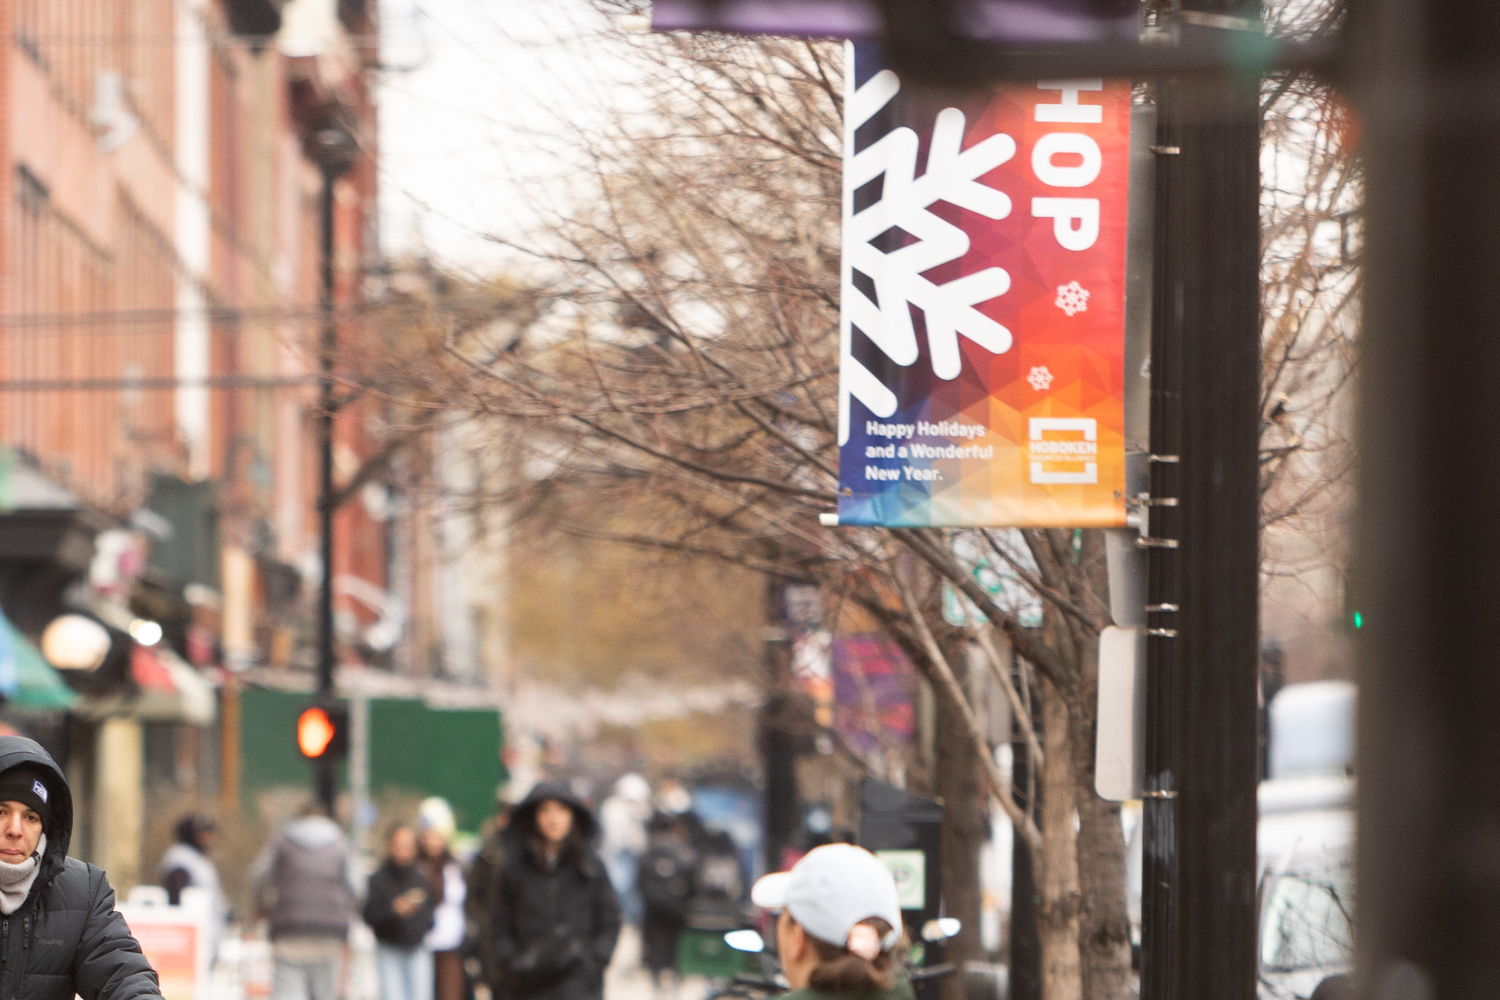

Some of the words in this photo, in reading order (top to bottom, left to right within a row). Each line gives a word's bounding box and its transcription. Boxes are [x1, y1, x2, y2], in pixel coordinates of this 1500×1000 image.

[866, 420, 915, 439] Happy
[917, 420, 986, 440] Holidays
[865, 443, 895, 458] and
[897, 446, 908, 458] a
[910, 443, 994, 459] Wonderful
[1029, 440, 1098, 454] HOBOKEN
[865, 465, 900, 480] New
[902, 465, 944, 480] Year.
